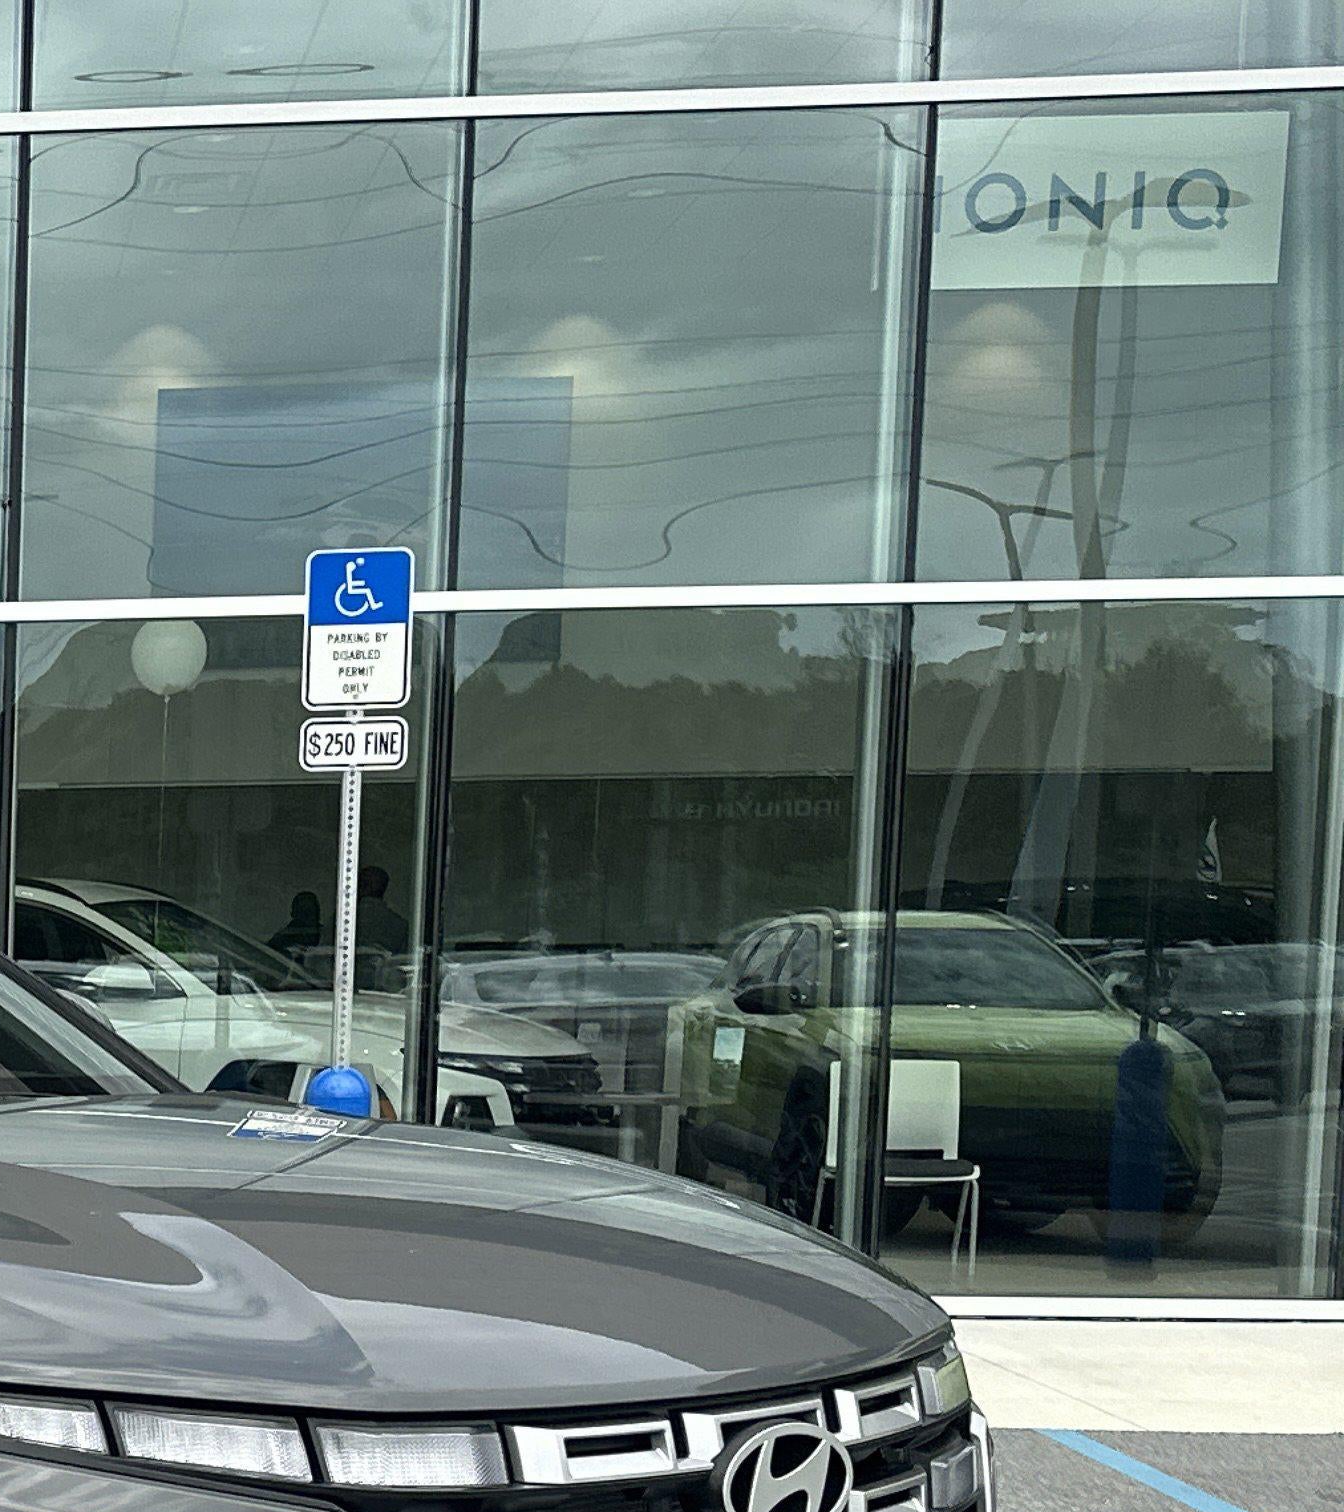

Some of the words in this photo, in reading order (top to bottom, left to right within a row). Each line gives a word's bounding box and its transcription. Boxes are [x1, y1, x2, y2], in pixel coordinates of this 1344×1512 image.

[935, 168, 1230, 233] IONIQ
[327, 632, 370, 644] PARKING
[375, 631, 388, 642] BY
[332, 649, 381, 661] DISABLED
[338, 665, 375, 677] PERMIT
[342, 683, 369, 695] ONLY
[308, 731, 355, 759] $250
[364, 731, 399, 755] FINE
